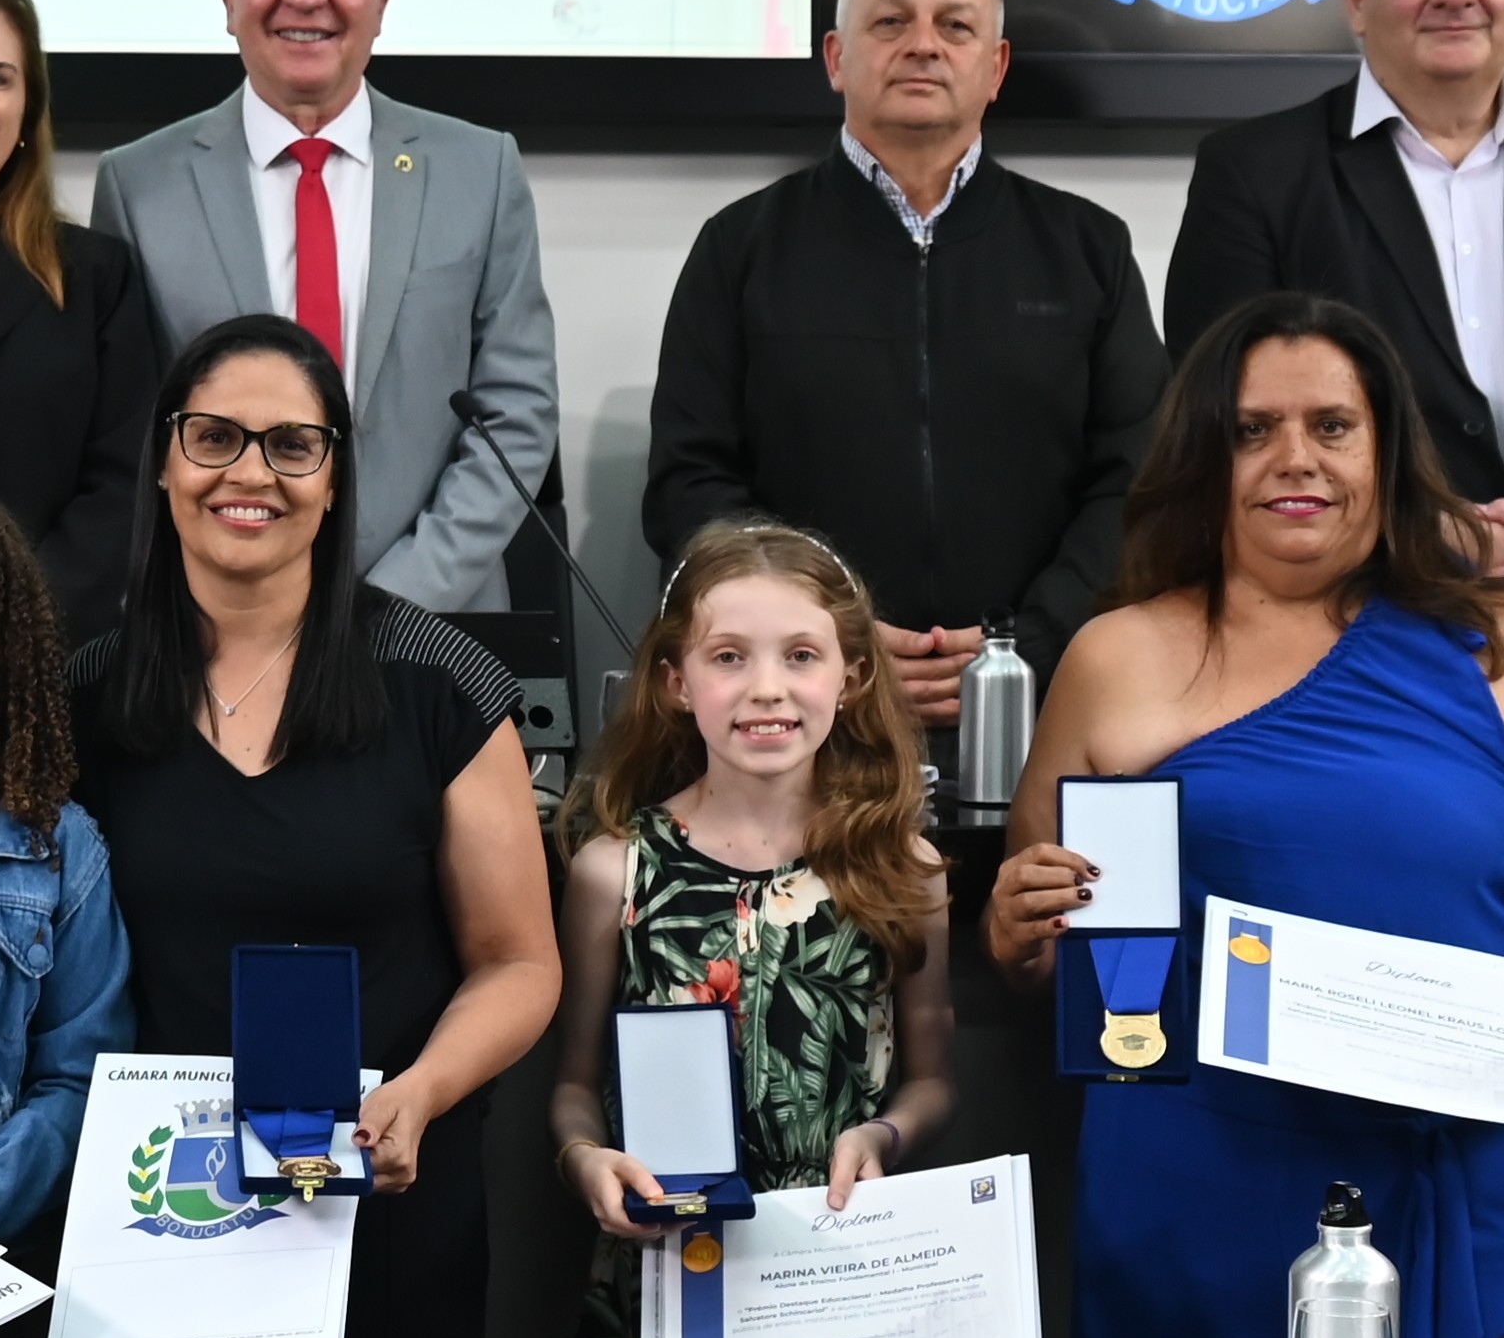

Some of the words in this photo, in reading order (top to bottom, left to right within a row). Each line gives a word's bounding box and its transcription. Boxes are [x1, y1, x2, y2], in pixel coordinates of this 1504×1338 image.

[1364, 961, 1456, 990] Diploma
[1279, 977, 1323, 992] MARIA
[1327, 988, 1375, 1005] ROSELI
[1380, 1000, 1433, 1018] LEONEL
[1438, 1014, 1483, 1030] KRAUS
[108, 1067, 168, 1082] CÂMARA
[173, 1071, 234, 1082] MUNICI
[156, 1209, 255, 1239] BOTUCATU
[810, 1209, 896, 1233] Diploma
[760, 1265, 815, 1284] MARINA
[821, 1259, 867, 1276] VIEIRA
[872, 1257, 889, 1268] DE
[894, 1244, 956, 1264] ALMEIDA
